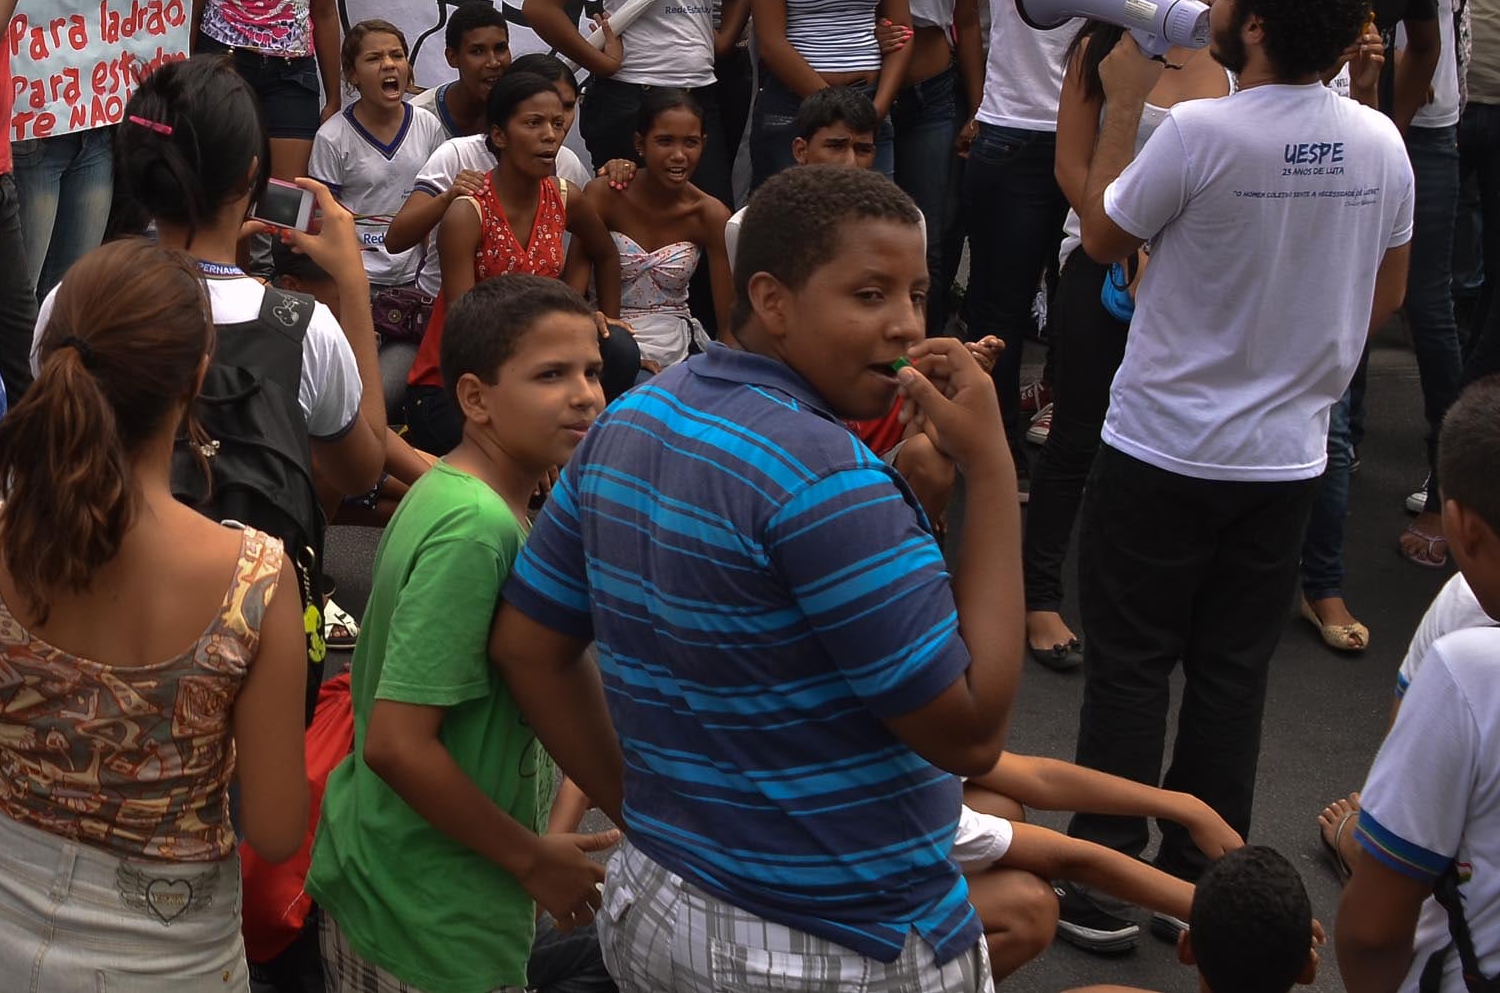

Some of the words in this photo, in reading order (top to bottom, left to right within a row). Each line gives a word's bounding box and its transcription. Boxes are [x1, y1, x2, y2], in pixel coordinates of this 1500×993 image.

[1284, 142, 1344, 164] UESPE
[1293, 168, 1312, 176] ANOS
[1313, 167, 1324, 175] DE
[1326, 166, 1344, 175] LUTA
